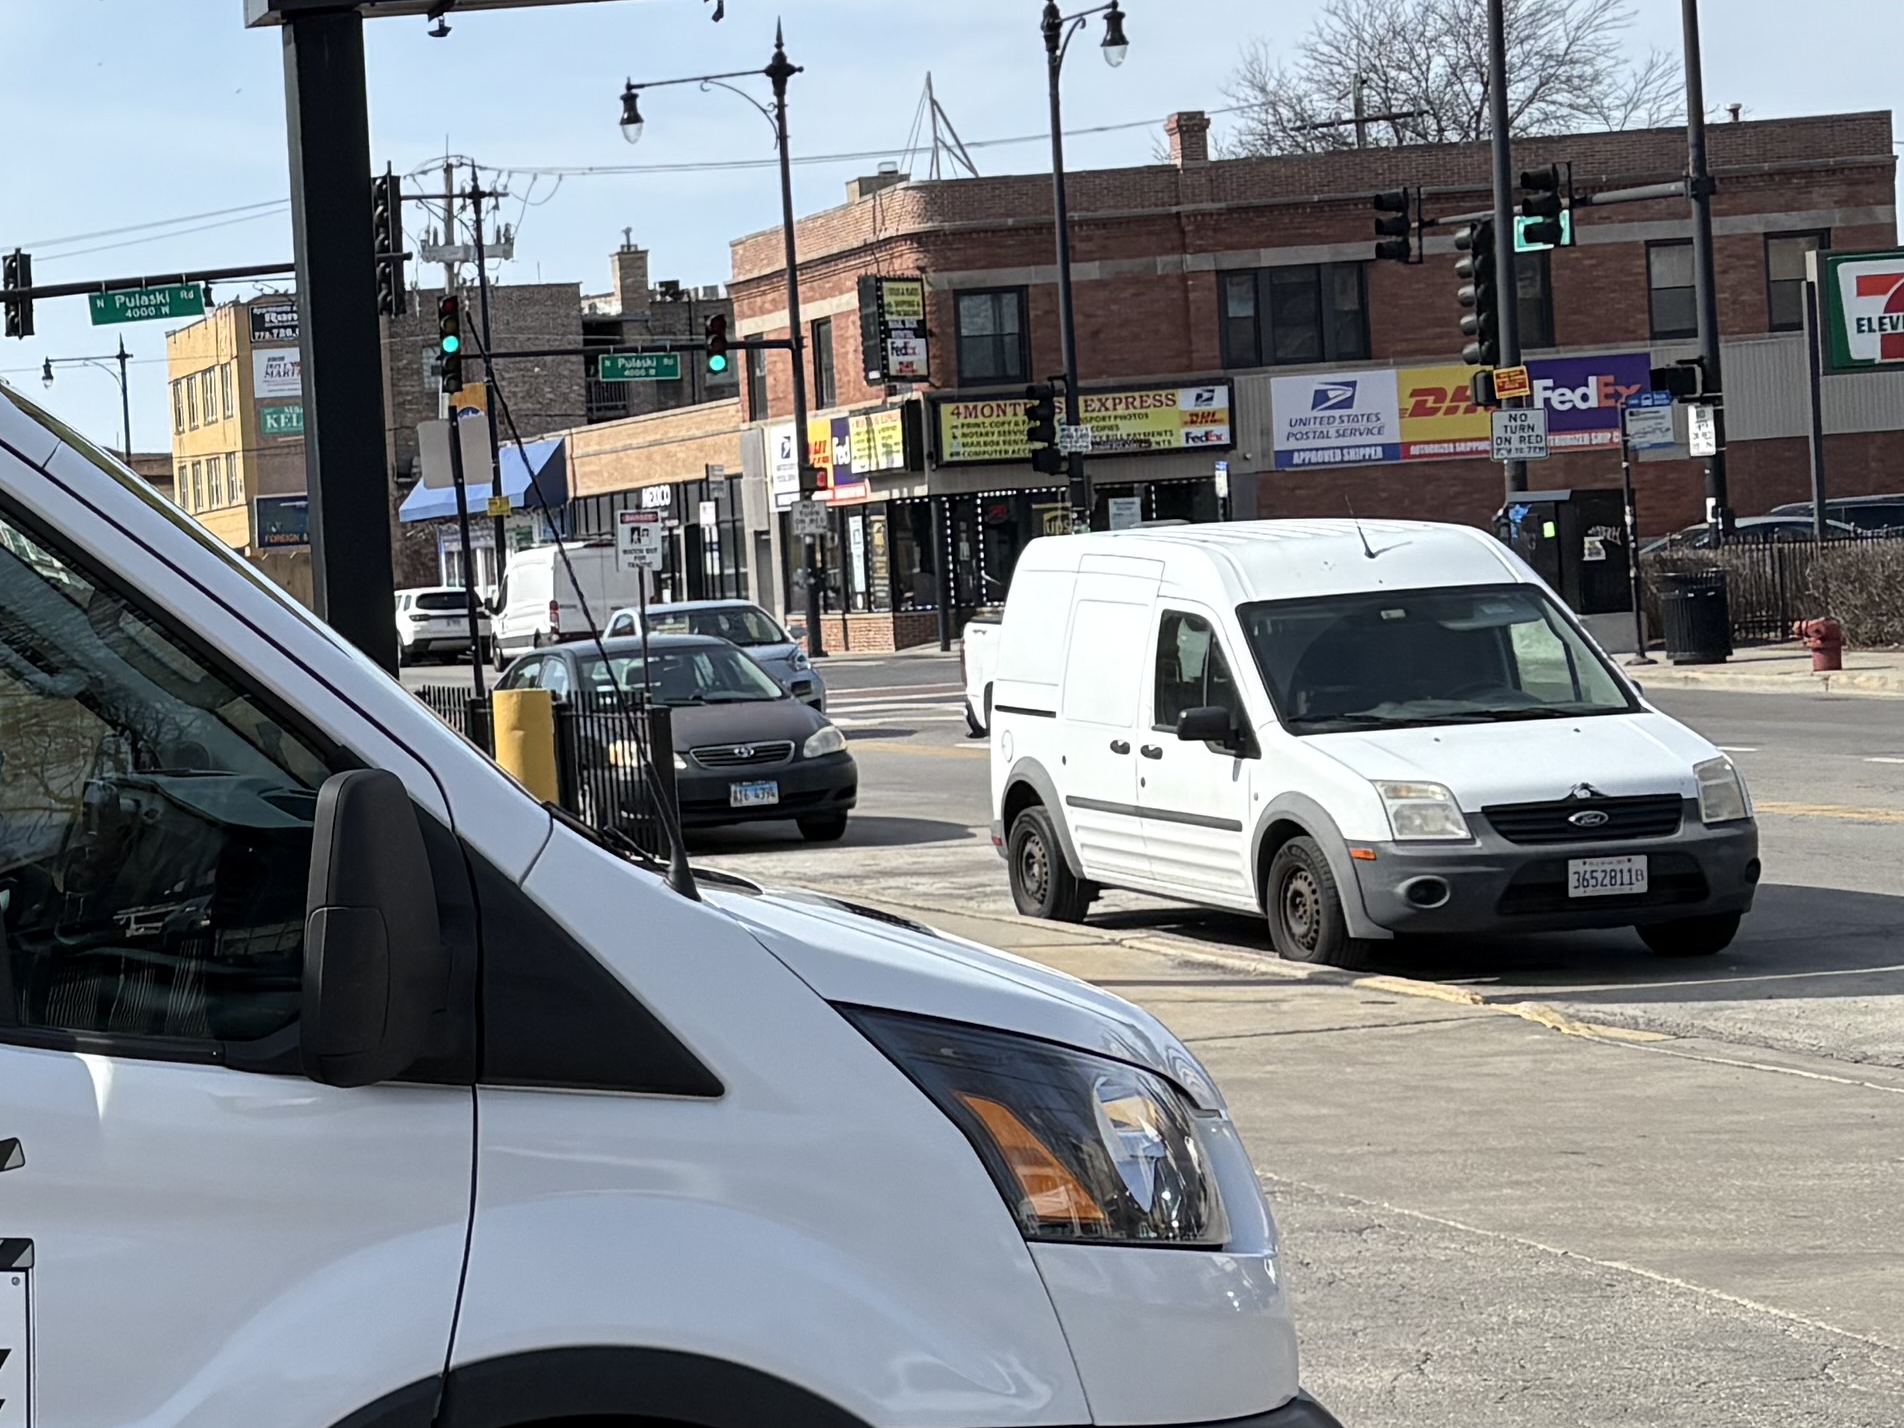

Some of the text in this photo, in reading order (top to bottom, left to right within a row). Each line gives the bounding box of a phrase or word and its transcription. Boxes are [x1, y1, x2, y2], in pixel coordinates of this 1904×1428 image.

[96, 290, 194, 309] N Pulaski Rd
[125, 306, 170, 318] 4000 W
[617, 357, 657, 369] Pulaski
[1533, 375, 1643, 411] FedEx
[1083, 393, 1177, 414] EXPRESS
[1114, 412, 1150, 422] PHOTOS
[1289, 412, 1381, 429] UNITED STATES
[1508, 413, 1528, 423] NO
[1287, 424, 1386, 441] POSTAL SERVICE
[1504, 423, 1536, 435] TURN
[1185, 430, 1224, 444] FedEx
[1496, 436, 1512, 446] ON
[1519, 434, 1542, 445] RED
[1293, 446, 1383, 464] APPROVED SHIPPER
